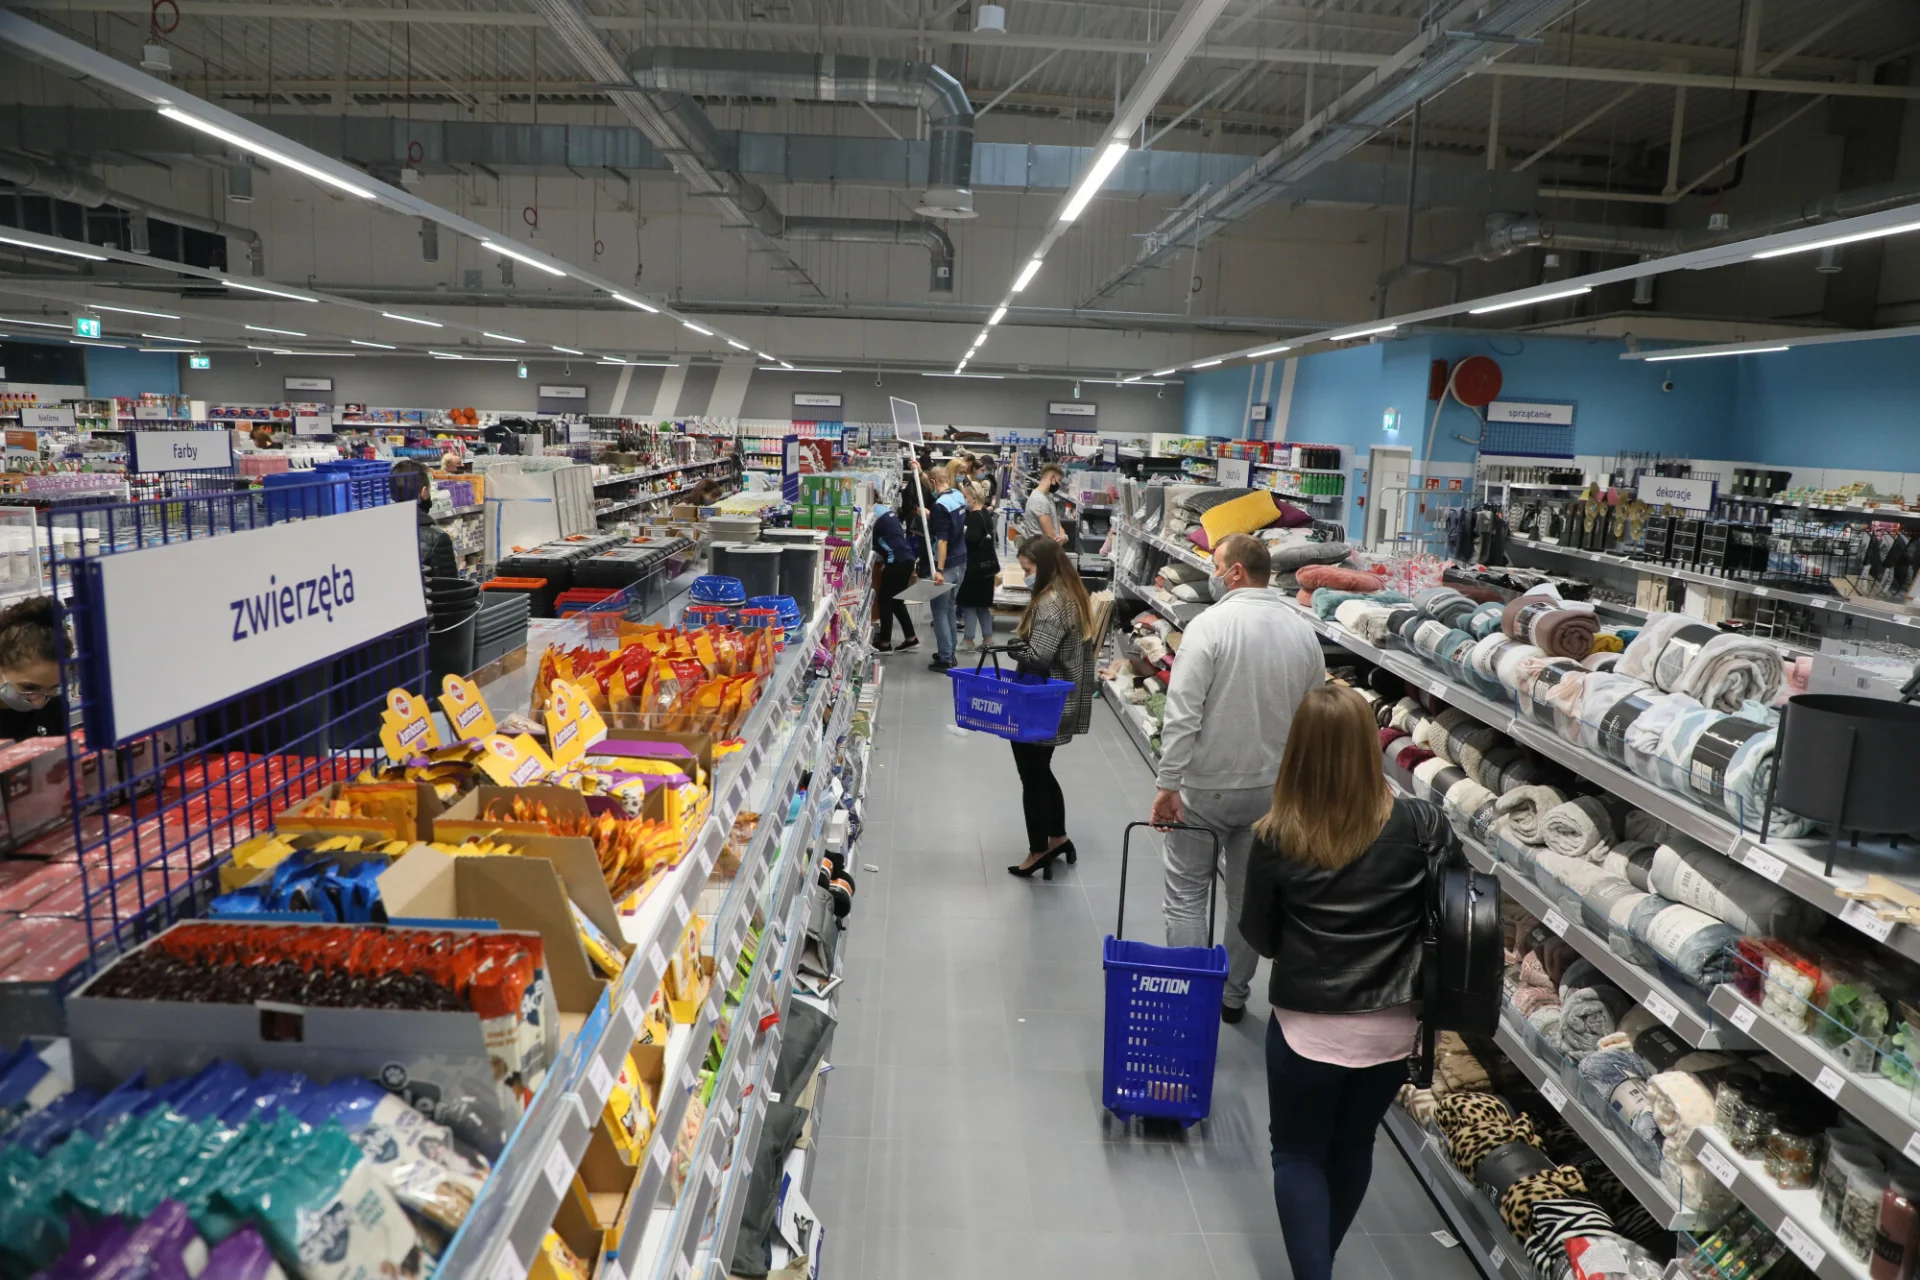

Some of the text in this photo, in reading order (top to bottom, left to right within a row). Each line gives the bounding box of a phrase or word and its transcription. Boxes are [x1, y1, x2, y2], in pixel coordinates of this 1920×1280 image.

[38, 414, 59, 422] bielizna
[1508, 409, 1552, 420] sprzątanie
[173, 444, 198, 461] farby
[1655, 487, 1692, 502] dekoracje
[229, 563, 355, 642] zwierzęta
[971, 697, 1003, 716] ACTION
[397, 716, 430, 747] Jumbone
[1138, 975, 1191, 996] ACTION
